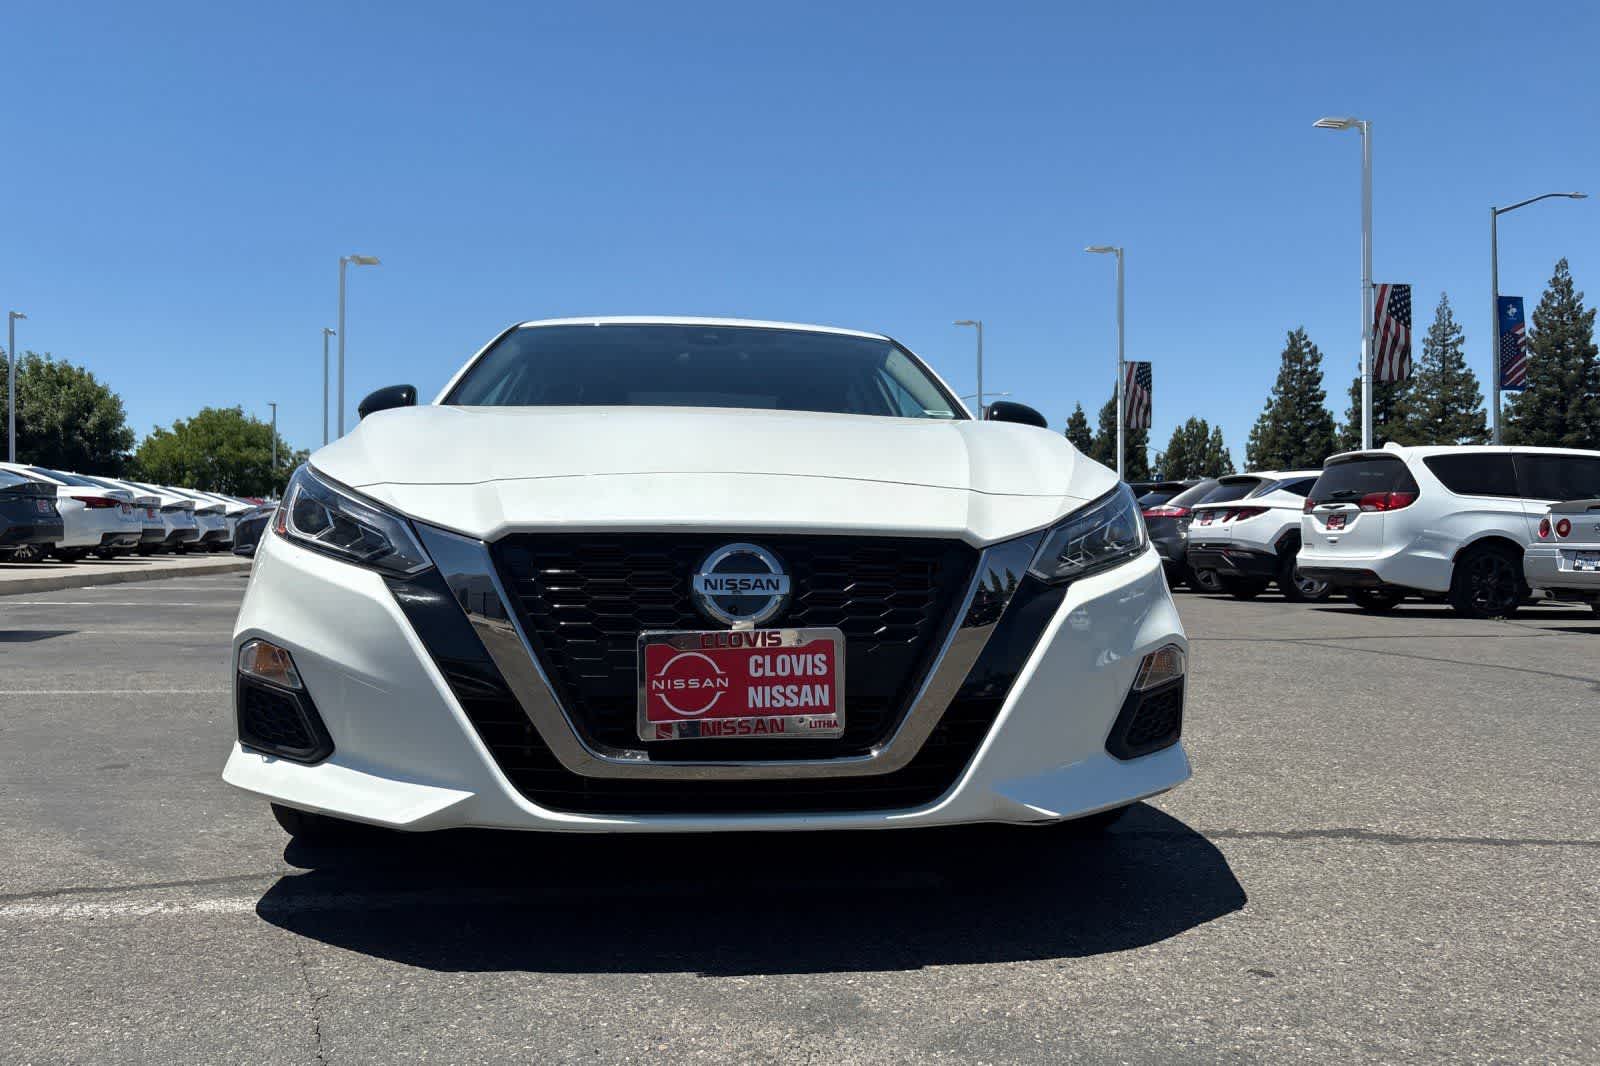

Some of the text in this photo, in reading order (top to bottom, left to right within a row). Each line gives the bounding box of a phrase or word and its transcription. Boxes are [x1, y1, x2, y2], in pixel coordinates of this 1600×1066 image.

[703, 578, 780, 591] NISSAN
[701, 630, 783, 649] CLOVIS
[749, 653, 828, 677] CLOVIS
[652, 677, 729, 690] NISSAN
[747, 684, 830, 708] NISSAN
[701, 718, 785, 736] NISSAN
[809, 719, 839, 729] LITHIA
